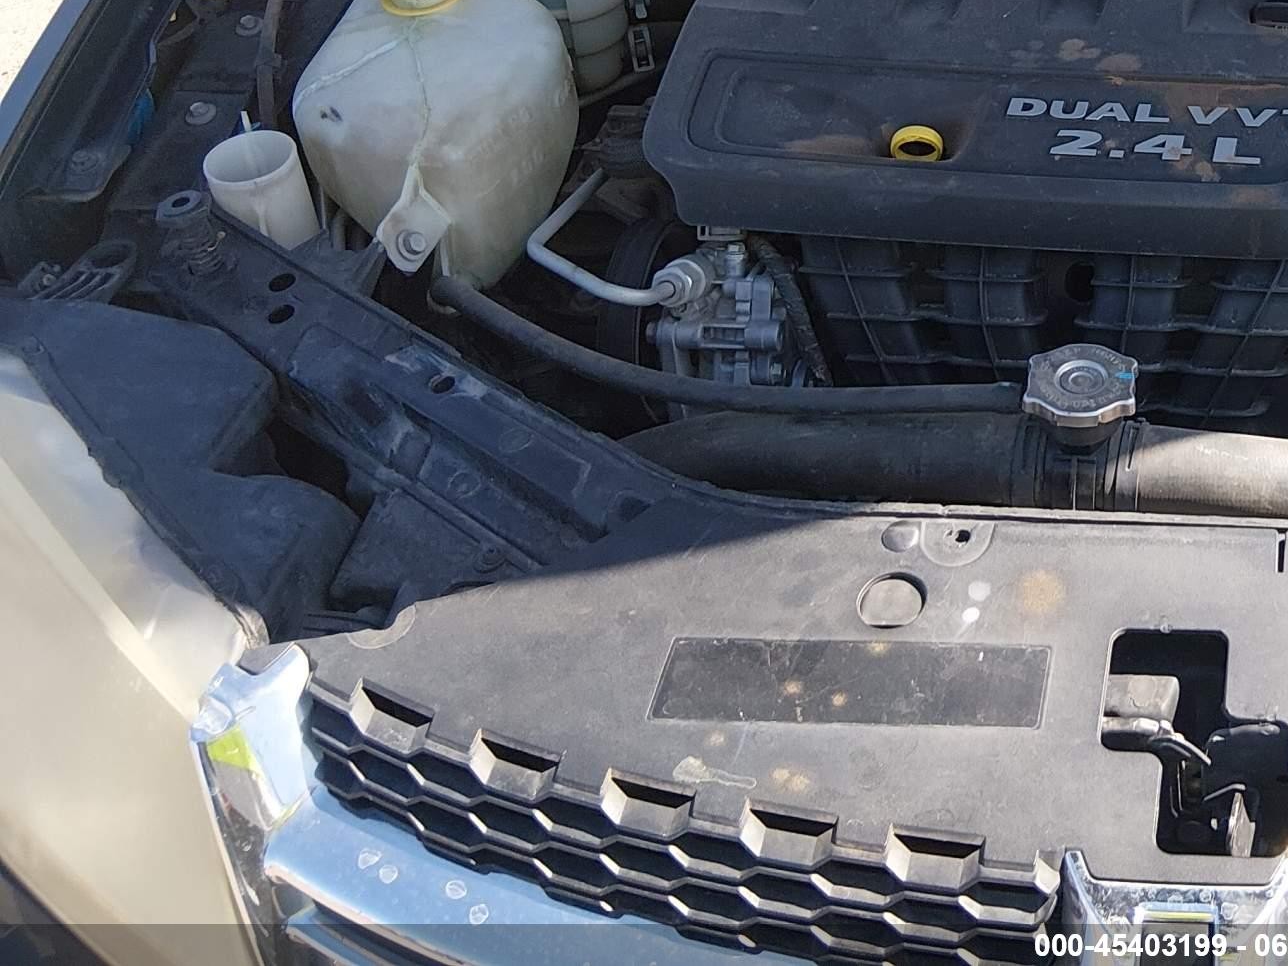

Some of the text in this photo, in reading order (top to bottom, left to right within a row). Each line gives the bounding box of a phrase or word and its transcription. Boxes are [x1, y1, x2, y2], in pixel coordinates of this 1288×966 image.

[1006, 97, 1170, 123] DUAL
[1049, 129, 1261, 165] 2.4 L
